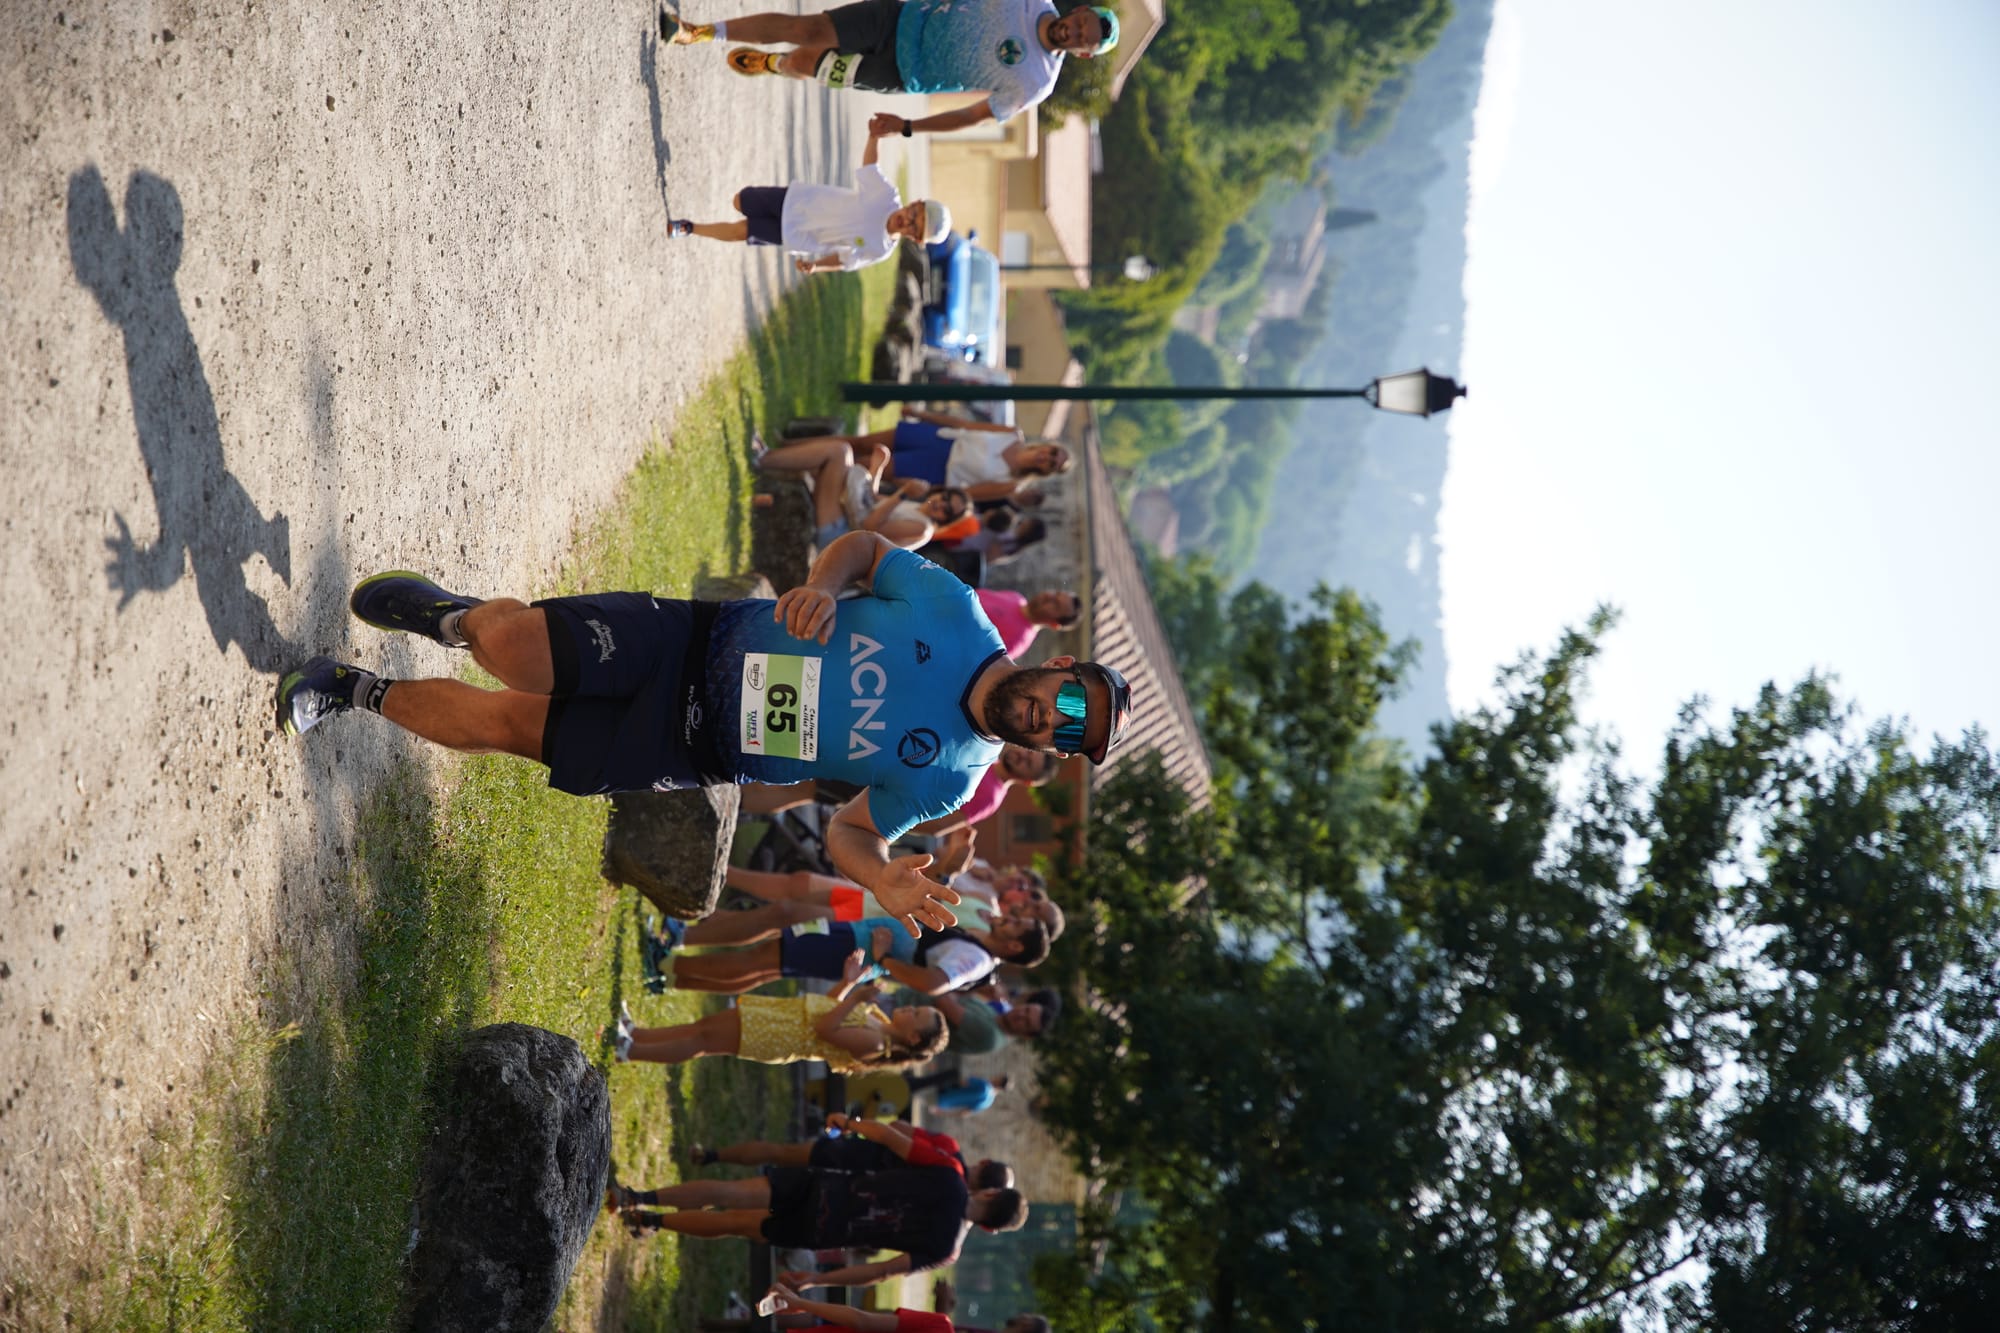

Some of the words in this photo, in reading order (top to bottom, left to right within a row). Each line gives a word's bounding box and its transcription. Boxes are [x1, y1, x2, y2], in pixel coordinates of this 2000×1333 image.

[830, 59, 847, 83] 83
[752, 664, 760, 686] BFP
[766, 683, 798, 733] 65
[848, 633, 887, 760] ACNA
[685, 704, 693, 746] SPORT
